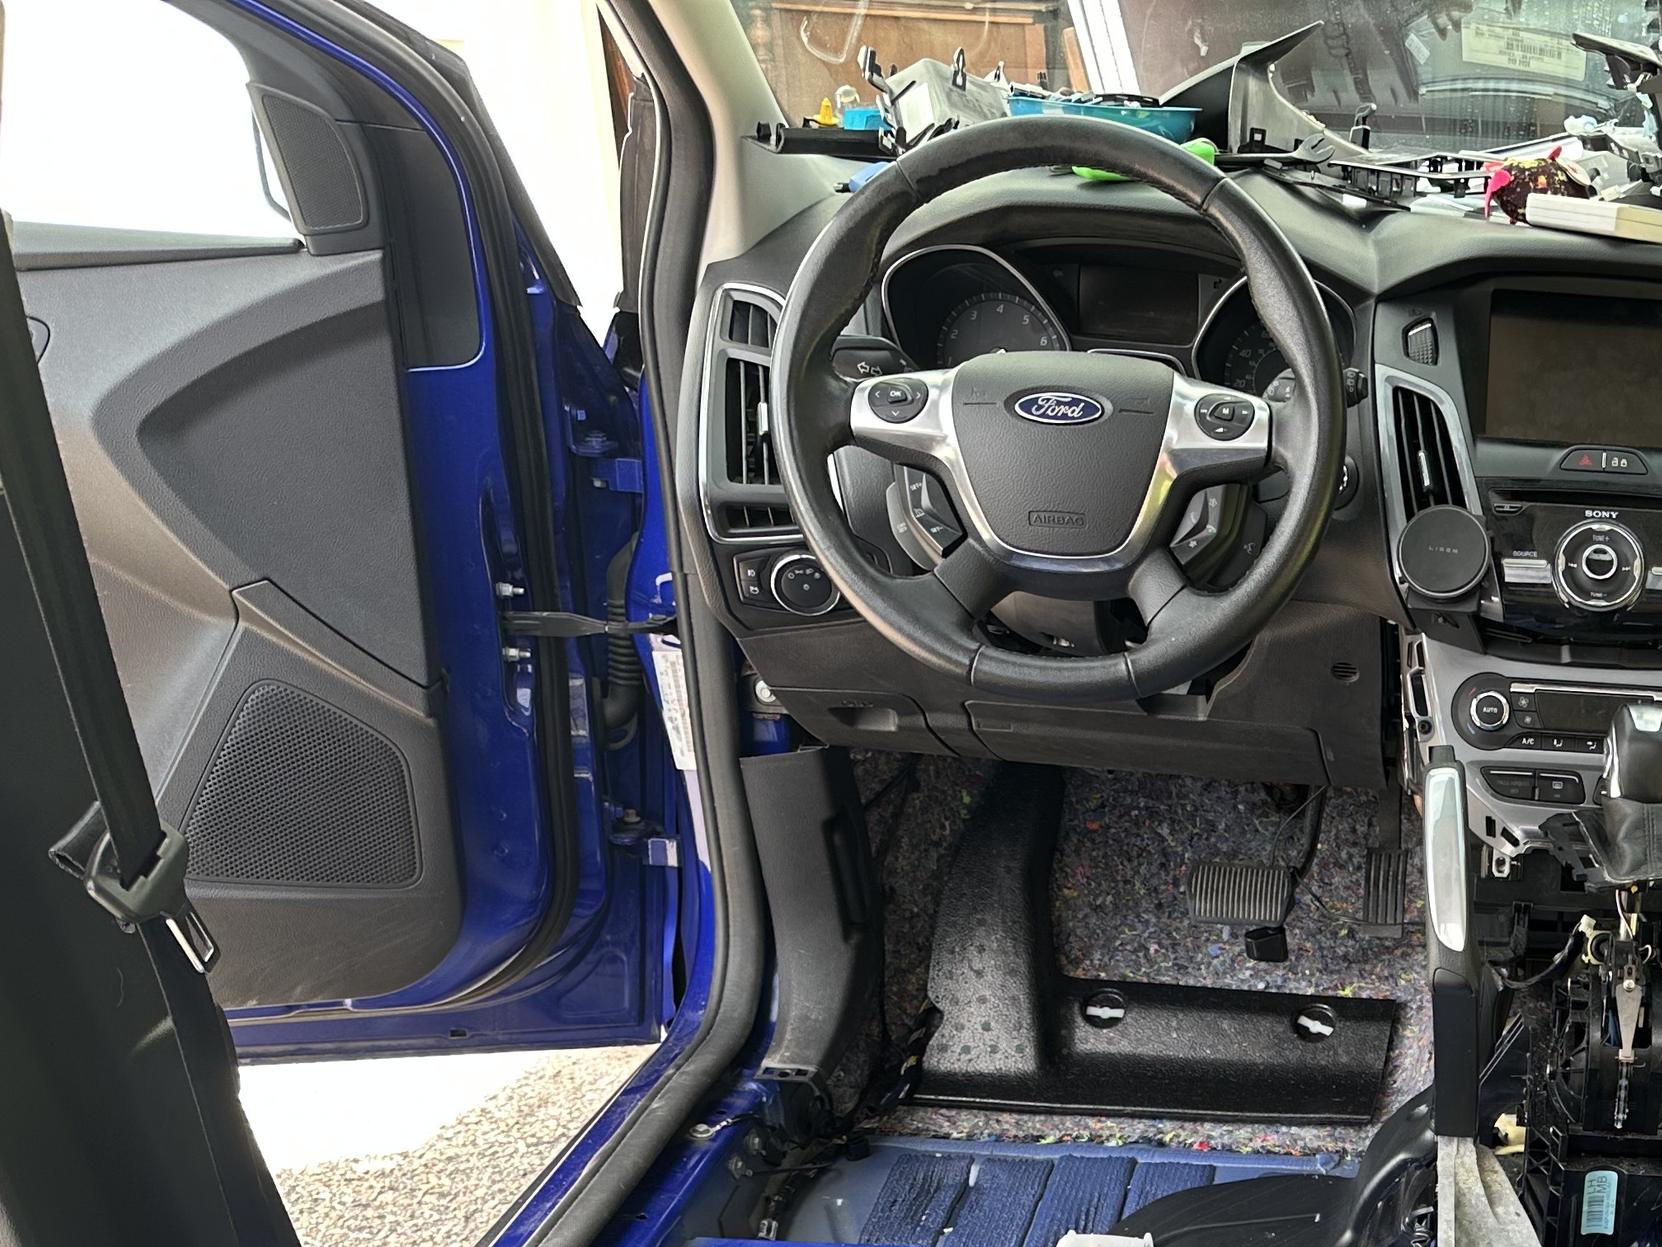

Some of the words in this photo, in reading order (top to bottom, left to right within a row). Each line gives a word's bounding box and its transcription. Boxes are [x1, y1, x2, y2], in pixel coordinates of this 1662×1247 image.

[996, 304, 1004, 313] 4
[971, 311, 978, 320] 3
[1022, 315, 1030, 325] 5
[950, 329, 958, 339] 2
[1040, 336, 1048, 346] 6
[1031, 395, 1085, 418] Ford
[1584, 509, 1619, 519] SONY
[1033, 514, 1085, 526] AIRBAG
[1512, 550, 1538, 558] SOURCE
[1482, 706, 1498, 714] AUTO
[1521, 737, 1535, 745] A/C
[1596, 1175, 1607, 1194] MB
